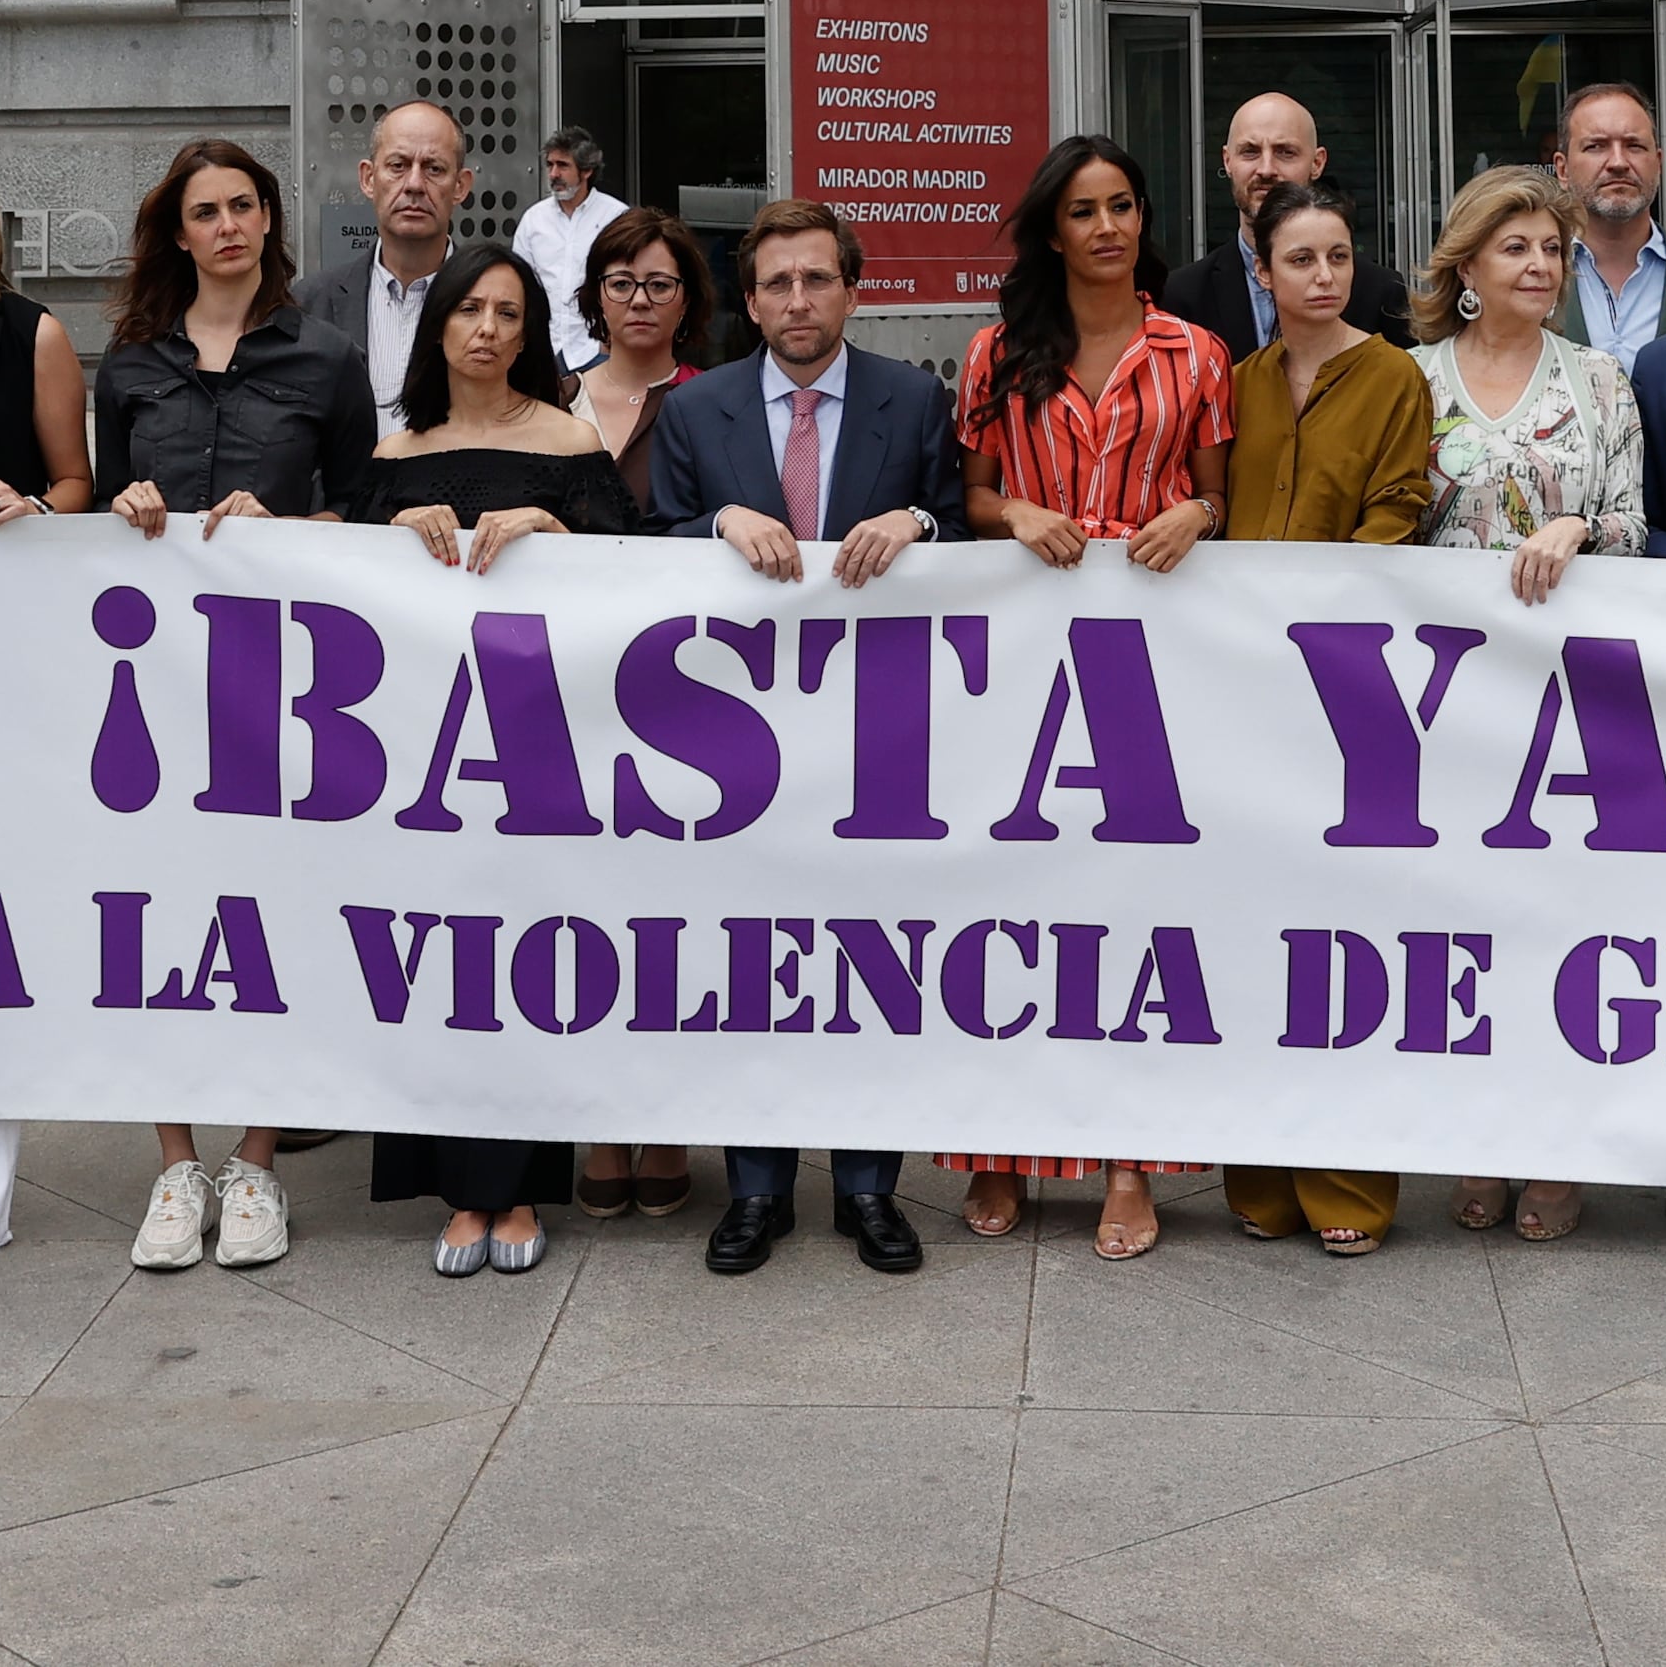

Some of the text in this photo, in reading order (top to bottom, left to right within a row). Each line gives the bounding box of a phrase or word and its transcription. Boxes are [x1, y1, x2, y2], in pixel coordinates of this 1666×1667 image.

[816, 19, 929, 43] EXHIBITONS
[816, 53, 881, 74] MUSIC
[817, 87, 937, 110] WORKSHOPS
[817, 121, 1013, 145] CULTURAL ACTIVITIES
[818, 168, 986, 189] MIRADOR MADRID
[950, 203, 1001, 223] DECK
[341, 226, 379, 236] SALIDA
[351, 238, 370, 249] Exit
[90, 584, 1201, 844] ¡BASTA
[91, 891, 288, 1014] LA
[339, 904, 1222, 1045] VIOLENCIA
[1278, 928, 1493, 1055] DE
